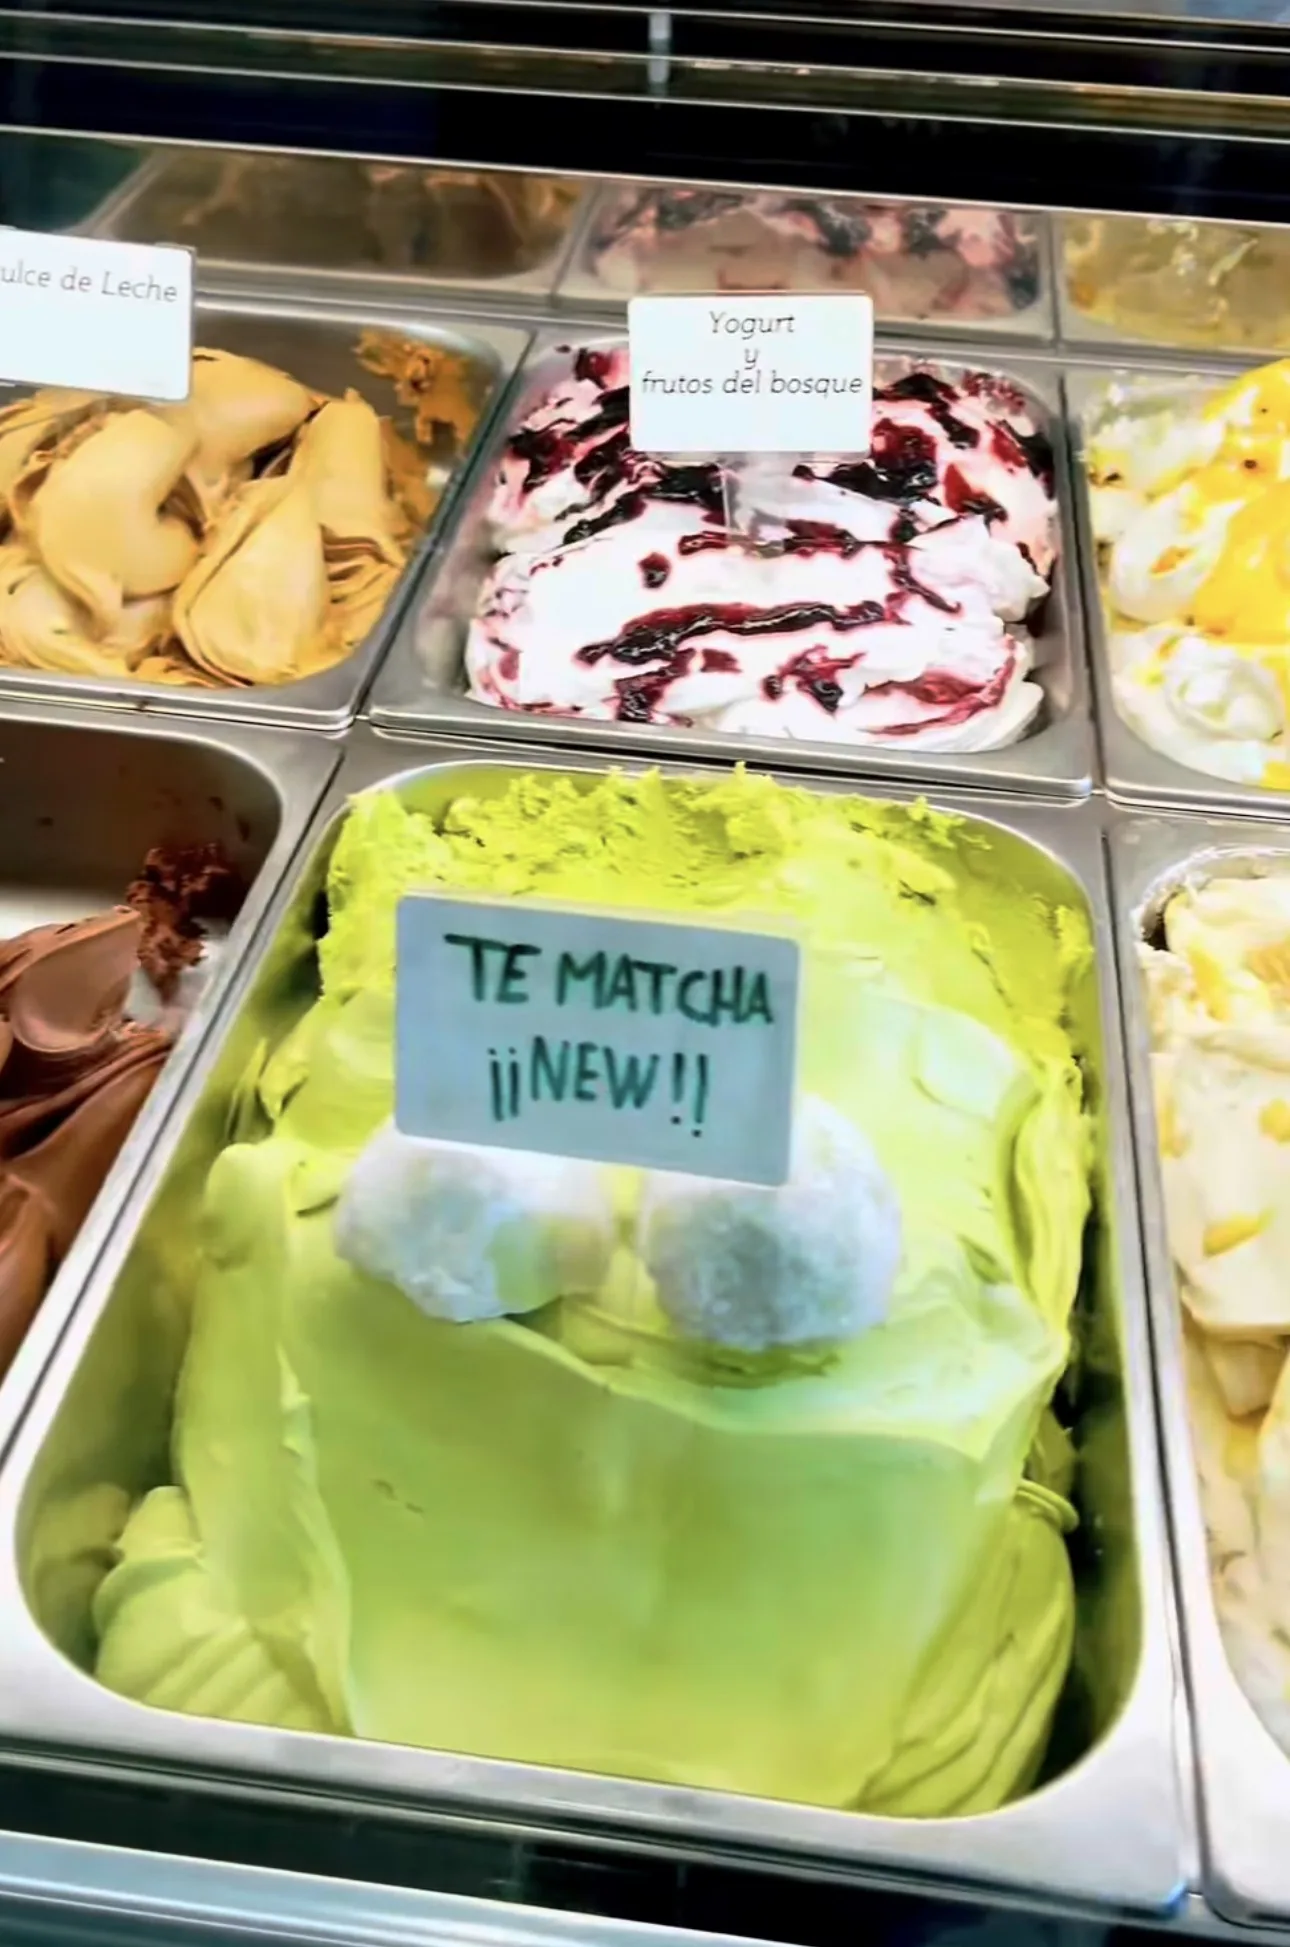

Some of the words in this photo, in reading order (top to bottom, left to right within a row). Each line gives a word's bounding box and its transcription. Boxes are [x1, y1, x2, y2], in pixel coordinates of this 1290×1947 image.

[0, 259, 51, 287] ulce
[60, 265, 92, 292] de
[101, 270, 178, 303] Leche
[709, 311, 795, 340] Yogurt
[743, 348, 759, 370] y
[642, 371, 713, 394] frutos
[722, 370, 762, 394] del
[770, 370, 863, 398] bosque
[444, 933, 542, 1002] TE
[556, 950, 773, 1027] MATCHA
